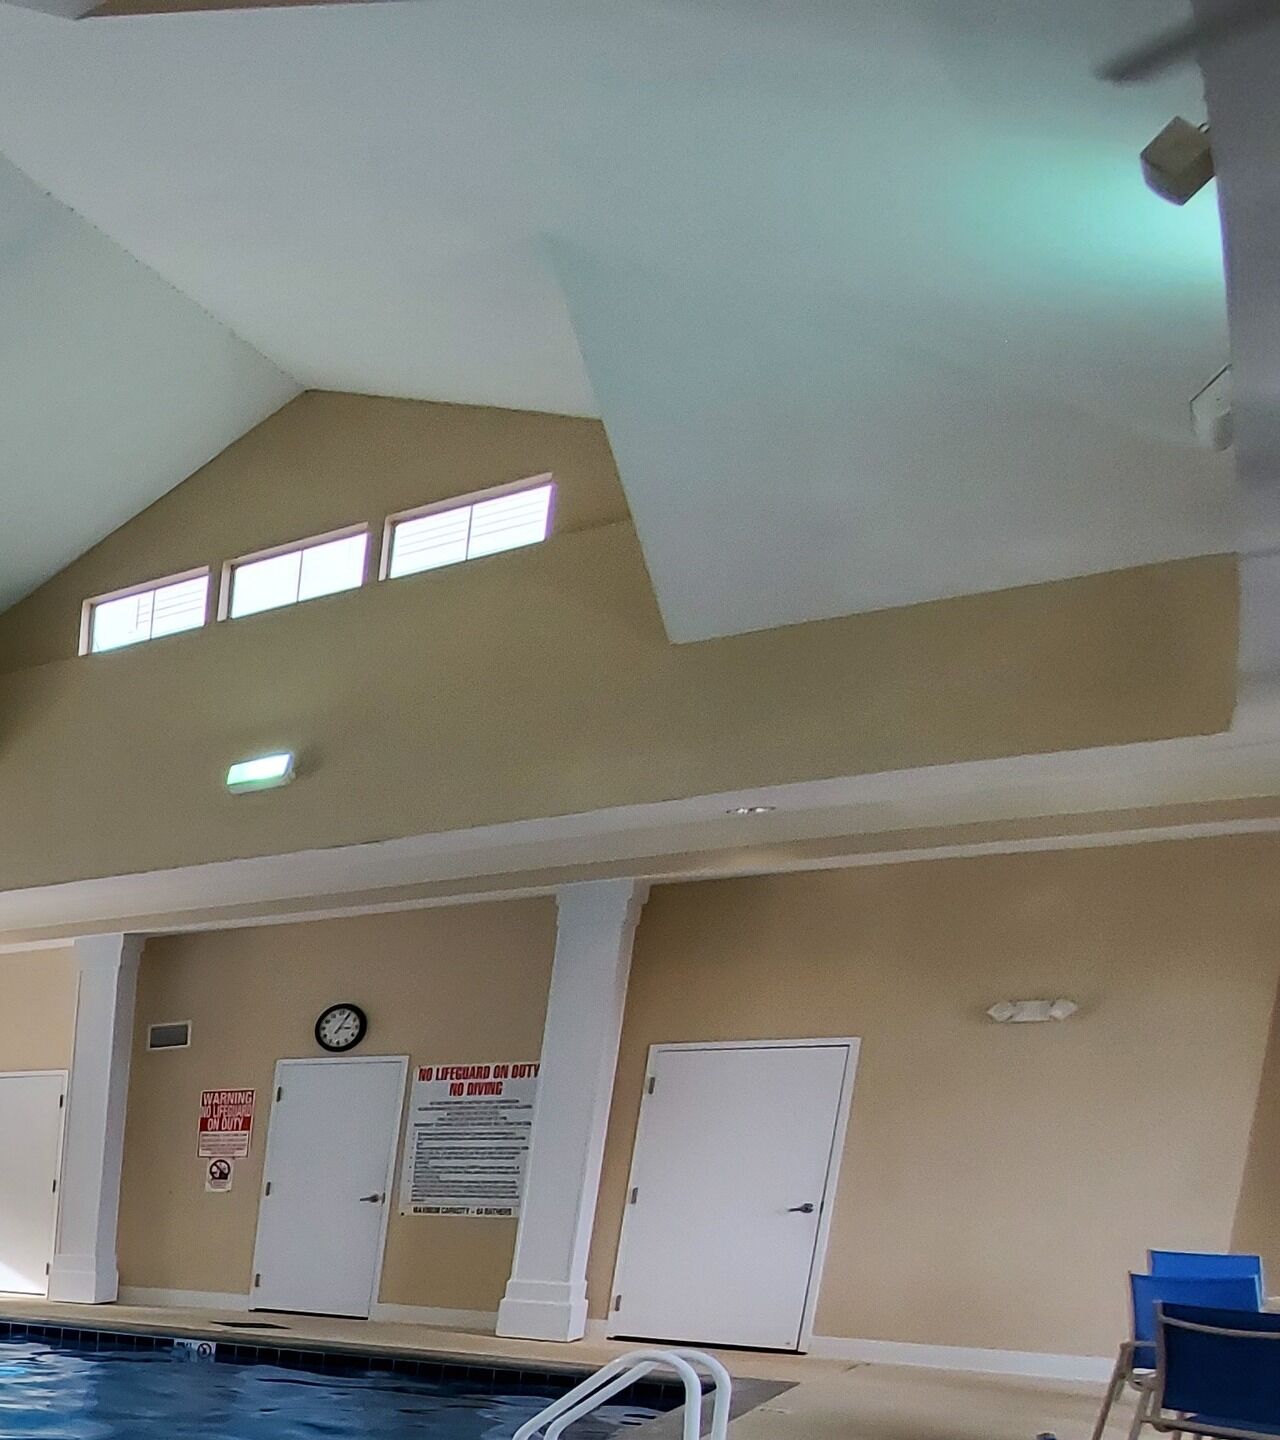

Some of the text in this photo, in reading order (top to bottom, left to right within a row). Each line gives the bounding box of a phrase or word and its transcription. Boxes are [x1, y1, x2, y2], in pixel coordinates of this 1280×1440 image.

[418, 1063, 540, 1081] NO LIFEGUARD ON DUTY
[449, 1081, 503, 1096] NO DIVING
[203, 1092, 252, 1105] WARNING
[213, 1104, 251, 1118] LIFEGUARD
[207, 1117, 244, 1131] ON DUTY
